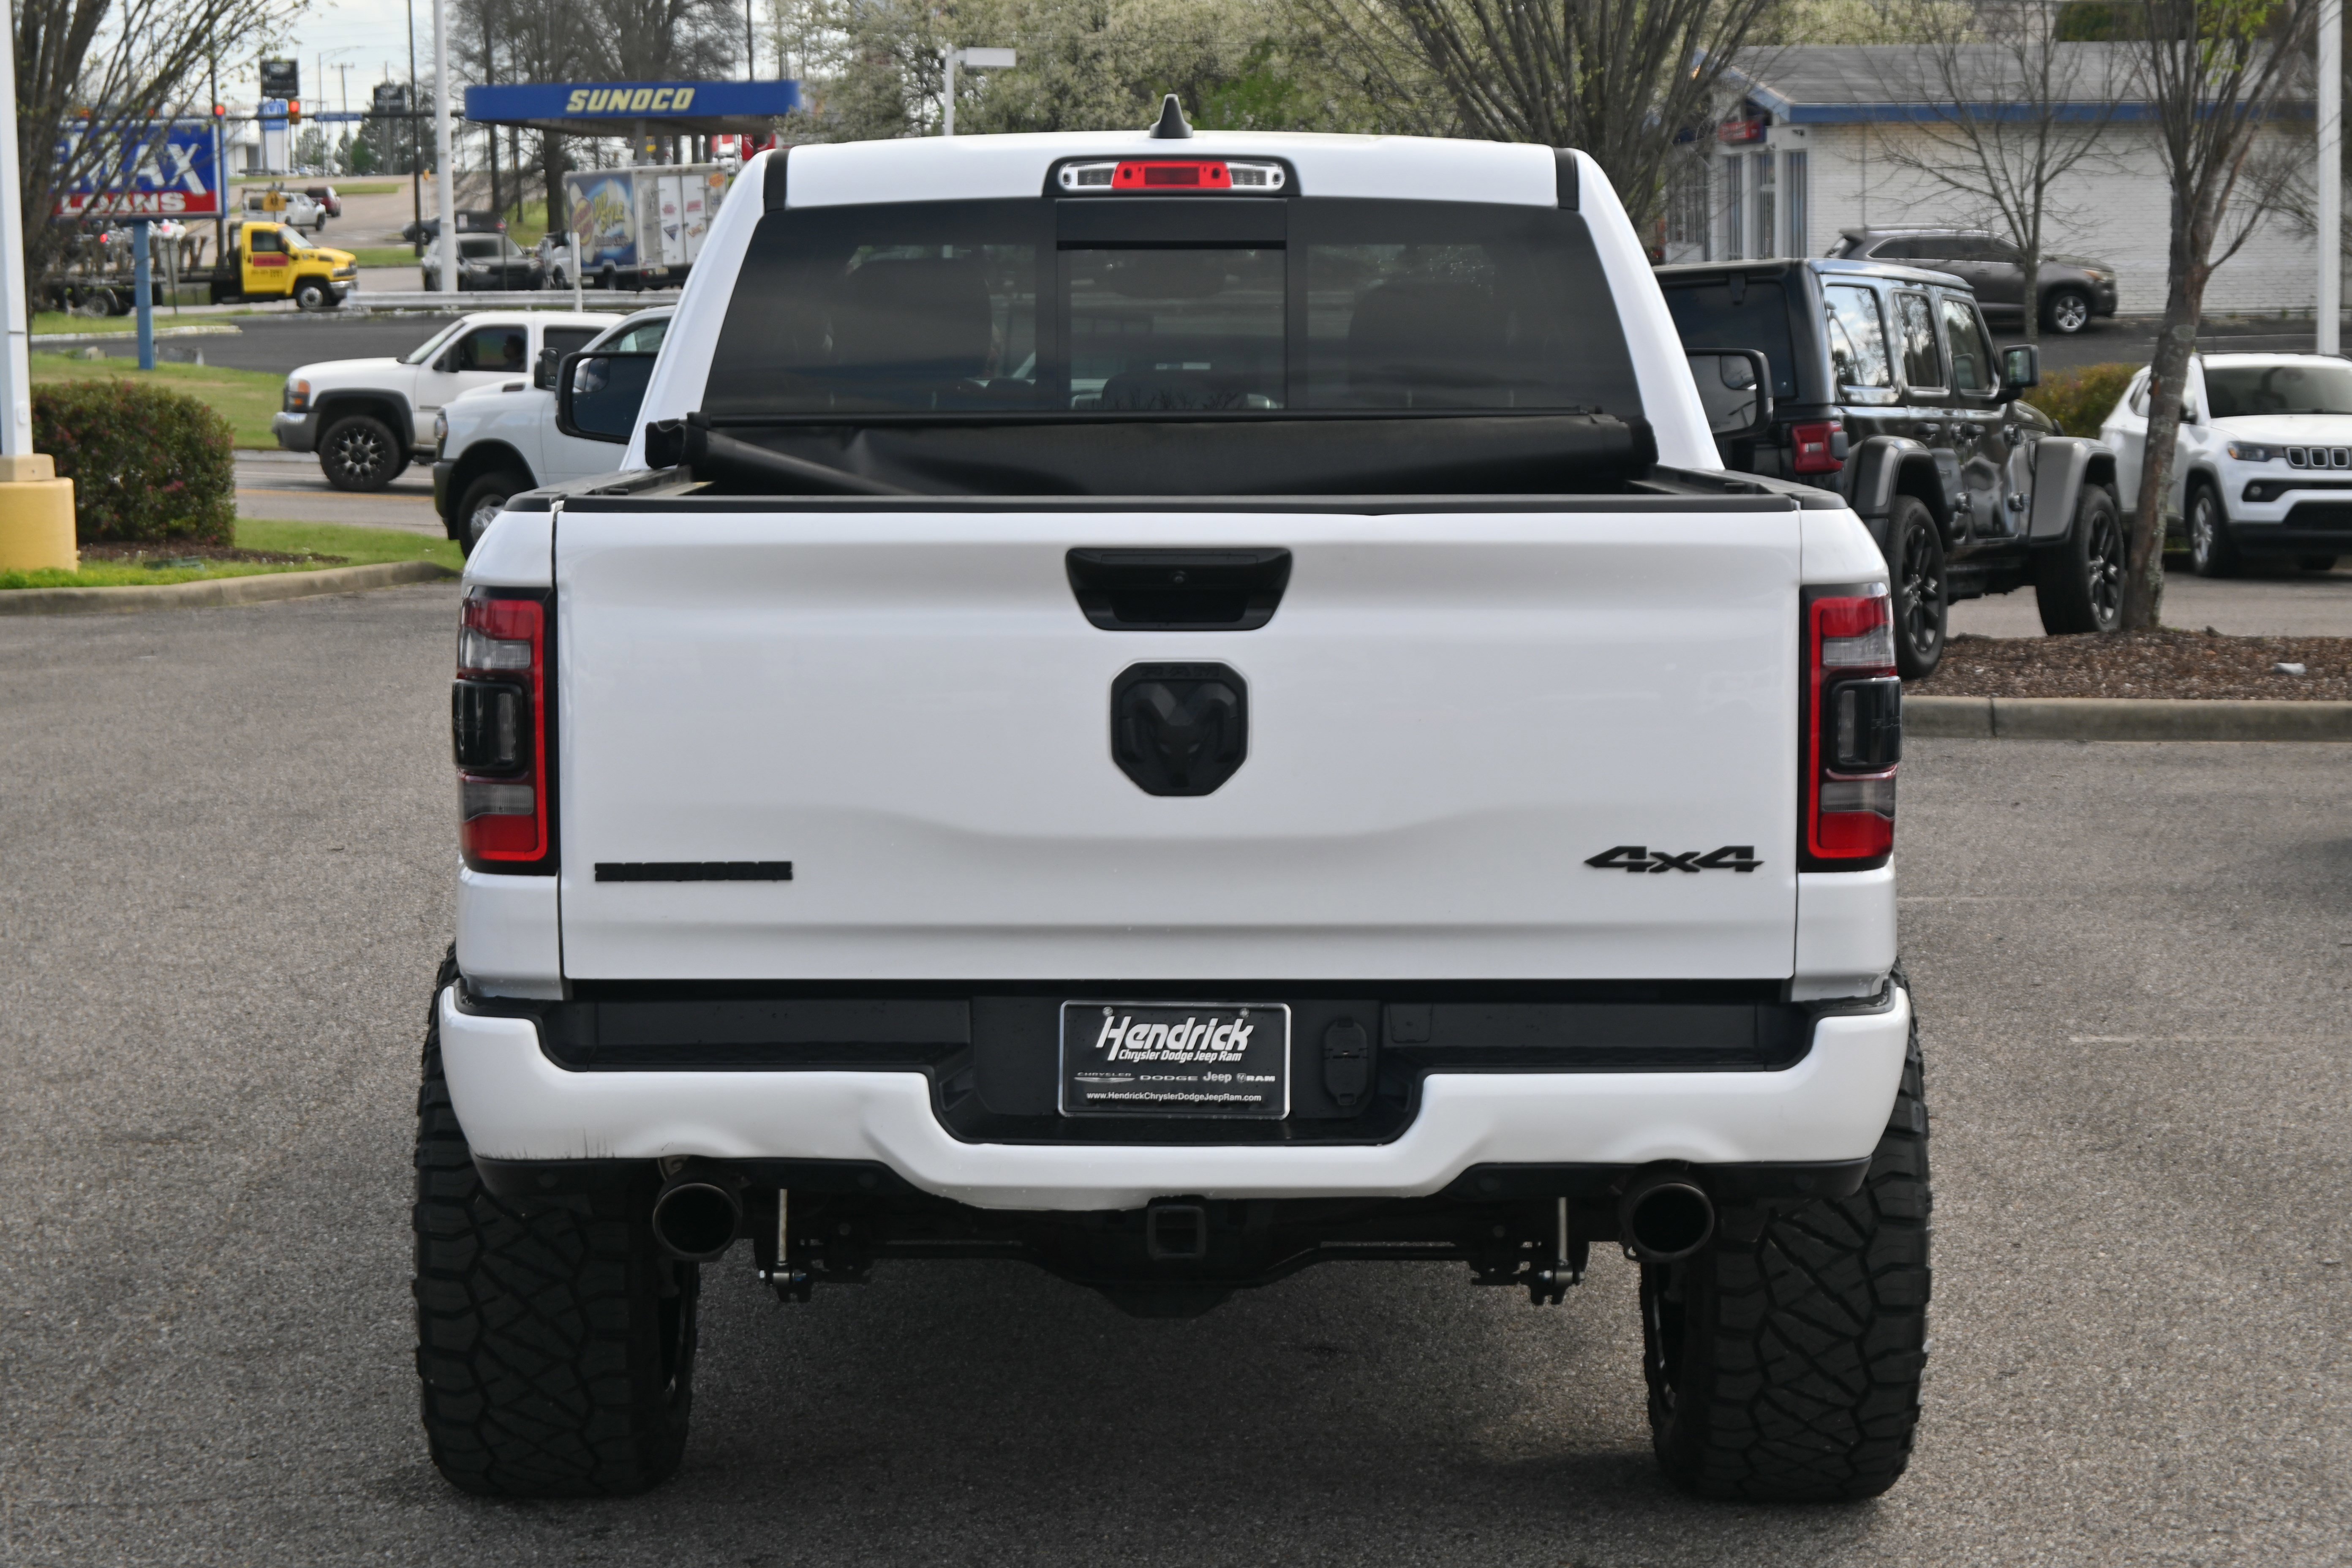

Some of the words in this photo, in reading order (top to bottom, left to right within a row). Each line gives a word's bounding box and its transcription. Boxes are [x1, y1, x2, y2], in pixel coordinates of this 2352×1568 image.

[566, 87, 695, 111] SUNOCO
[61, 192, 186, 213] LOANS
[1139, 666, 1220, 676] RAM
[1584, 845, 1765, 873] 4x4
[1095, 1016, 1254, 1061] Hendrick
[1119, 1049, 1160, 1062] Chrysler
[1161, 1050, 1193, 1063] Dodge
[1194, 1051, 1217, 1064] Jeep
[1218, 1051, 1242, 1062] Ram
[1203, 1071, 1232, 1083] Jeep
[1086, 1091, 1262, 1102] www.HendrickChryslerDodgeJeepRam.com
